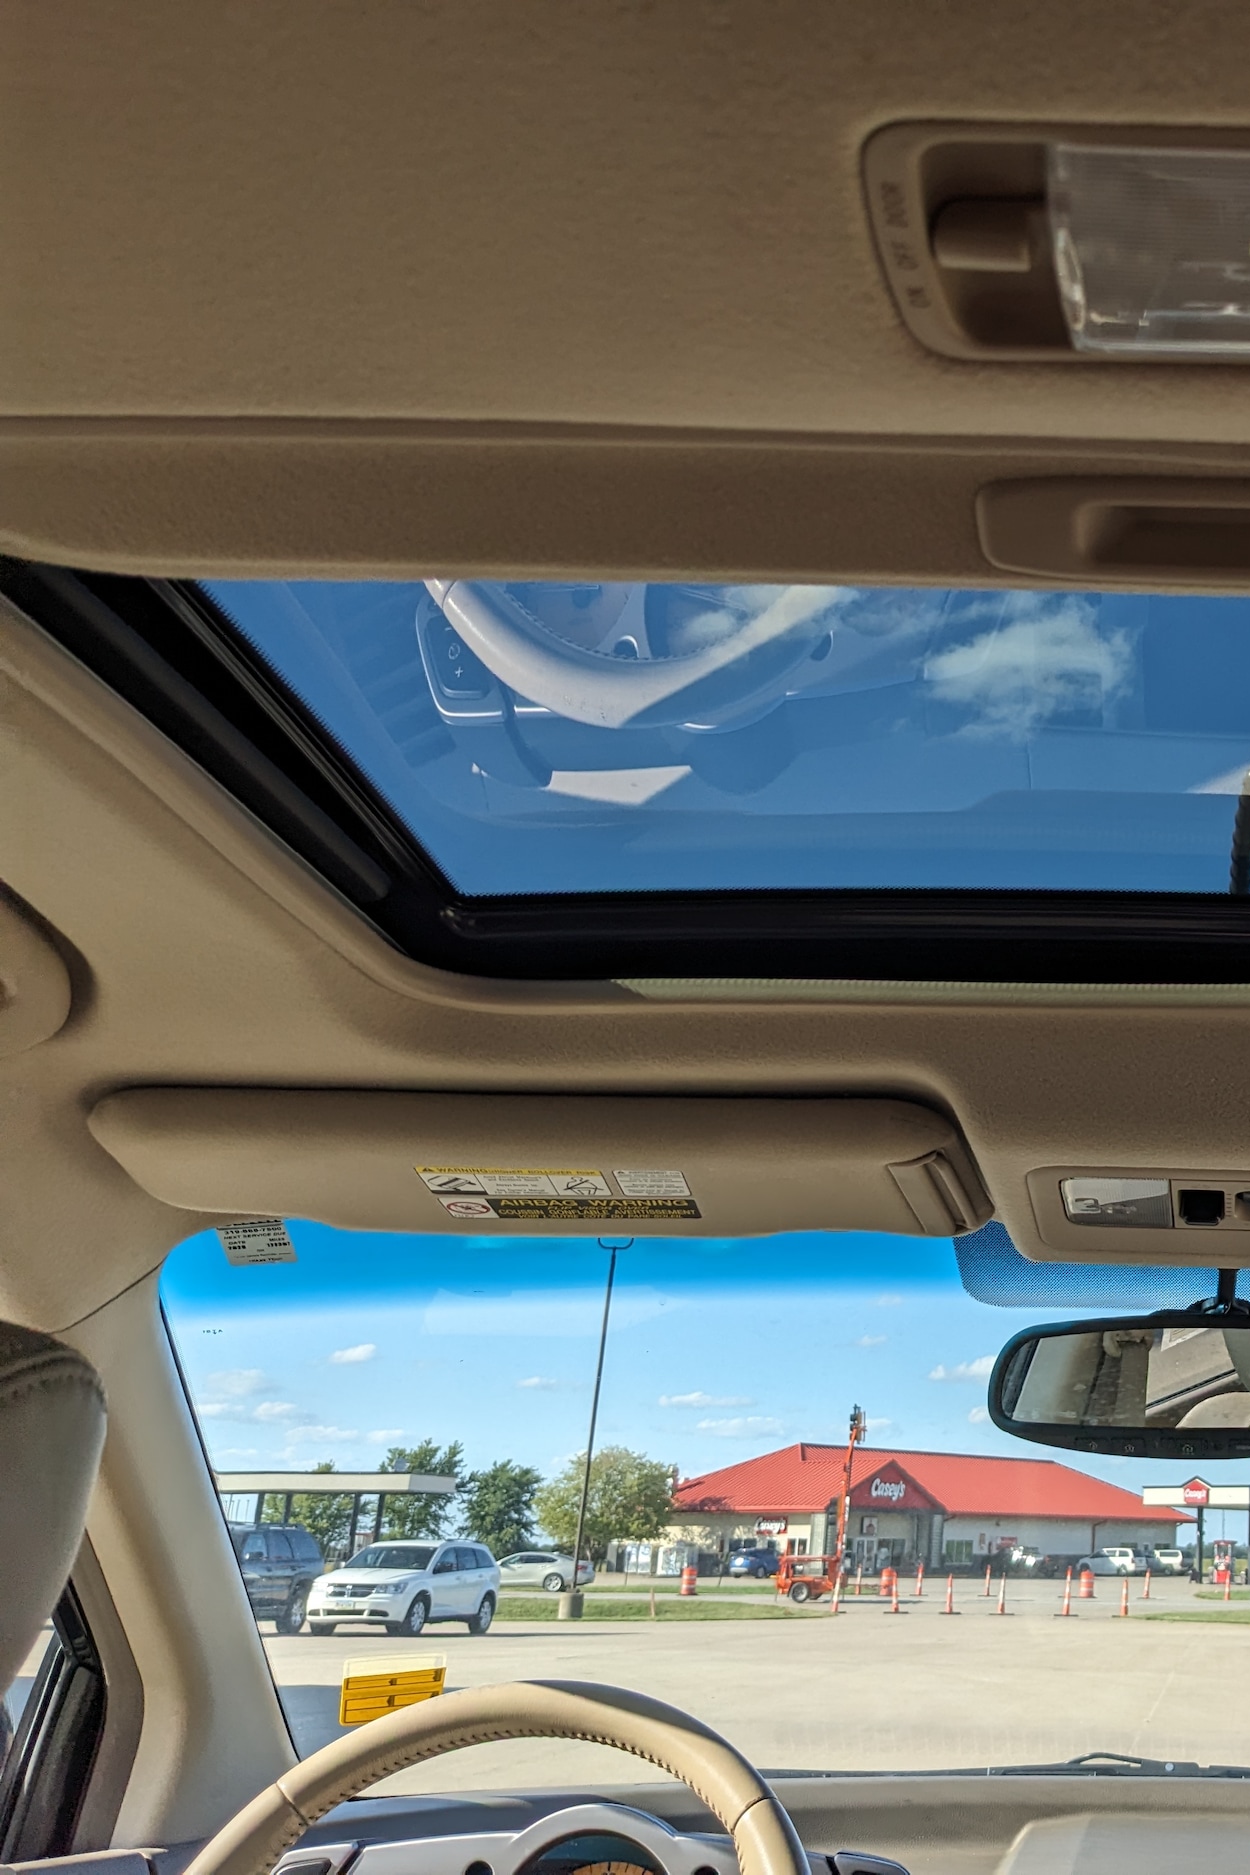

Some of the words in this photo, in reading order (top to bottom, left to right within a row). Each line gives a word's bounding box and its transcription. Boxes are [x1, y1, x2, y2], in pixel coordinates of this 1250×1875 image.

[500, 1199, 579, 1207] AIRBAG
[588, 1199, 689, 1207] WARNING
[871, 1477, 906, 1501] Casey's
[754, 1516, 786, 1534] Casey's
